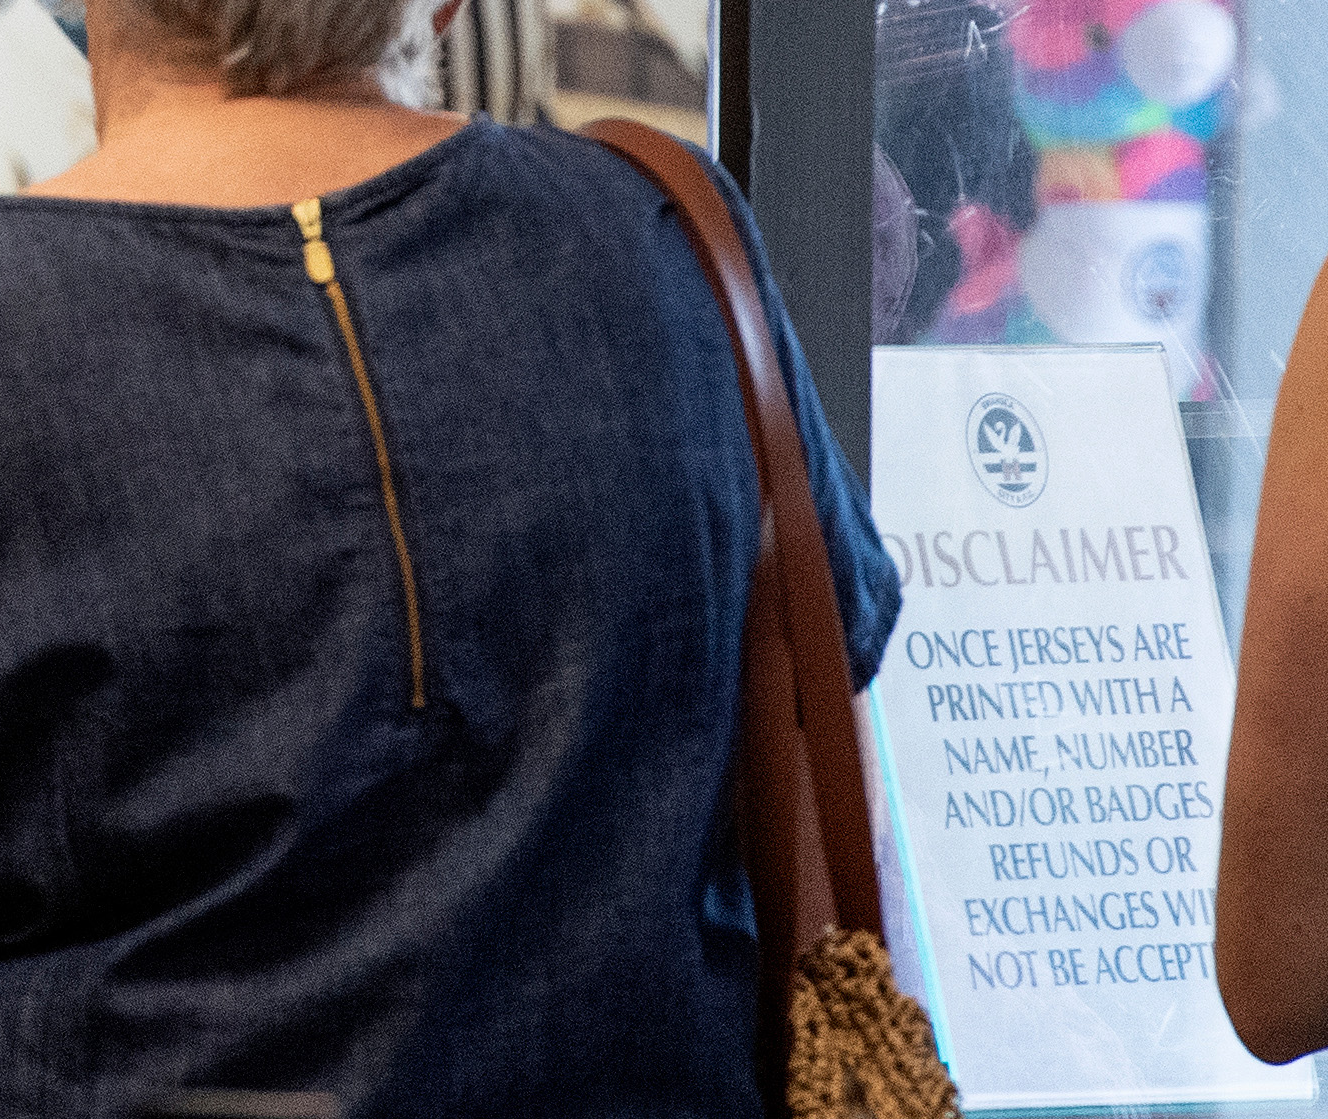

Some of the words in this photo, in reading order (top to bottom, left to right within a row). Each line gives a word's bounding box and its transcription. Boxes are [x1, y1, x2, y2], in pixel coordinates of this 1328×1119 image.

[880, 524, 1191, 588] DISCLAIMER
[906, 630, 1002, 670] ONCE
[1008, 625, 1125, 674] JERSEYS
[1134, 623, 1193, 662] ARE
[927, 680, 1064, 722] PRINTED
[1069, 678, 1161, 716] WITH
[1171, 676, 1193, 713] A
[943, 735, 1050, 779] NAME,
[1055, 729, 1199, 771] NUMBER
[945, 787, 1079, 829] AND/OR
[1084, 781, 1214, 824] BADGES
[989, 838, 1139, 881] REFUNDS
[1146, 836, 1198, 875] OR
[964, 890, 1160, 937] EXCHANGES
[968, 950, 1038, 990] NOT
[1048, 948, 1089, 987] BE
